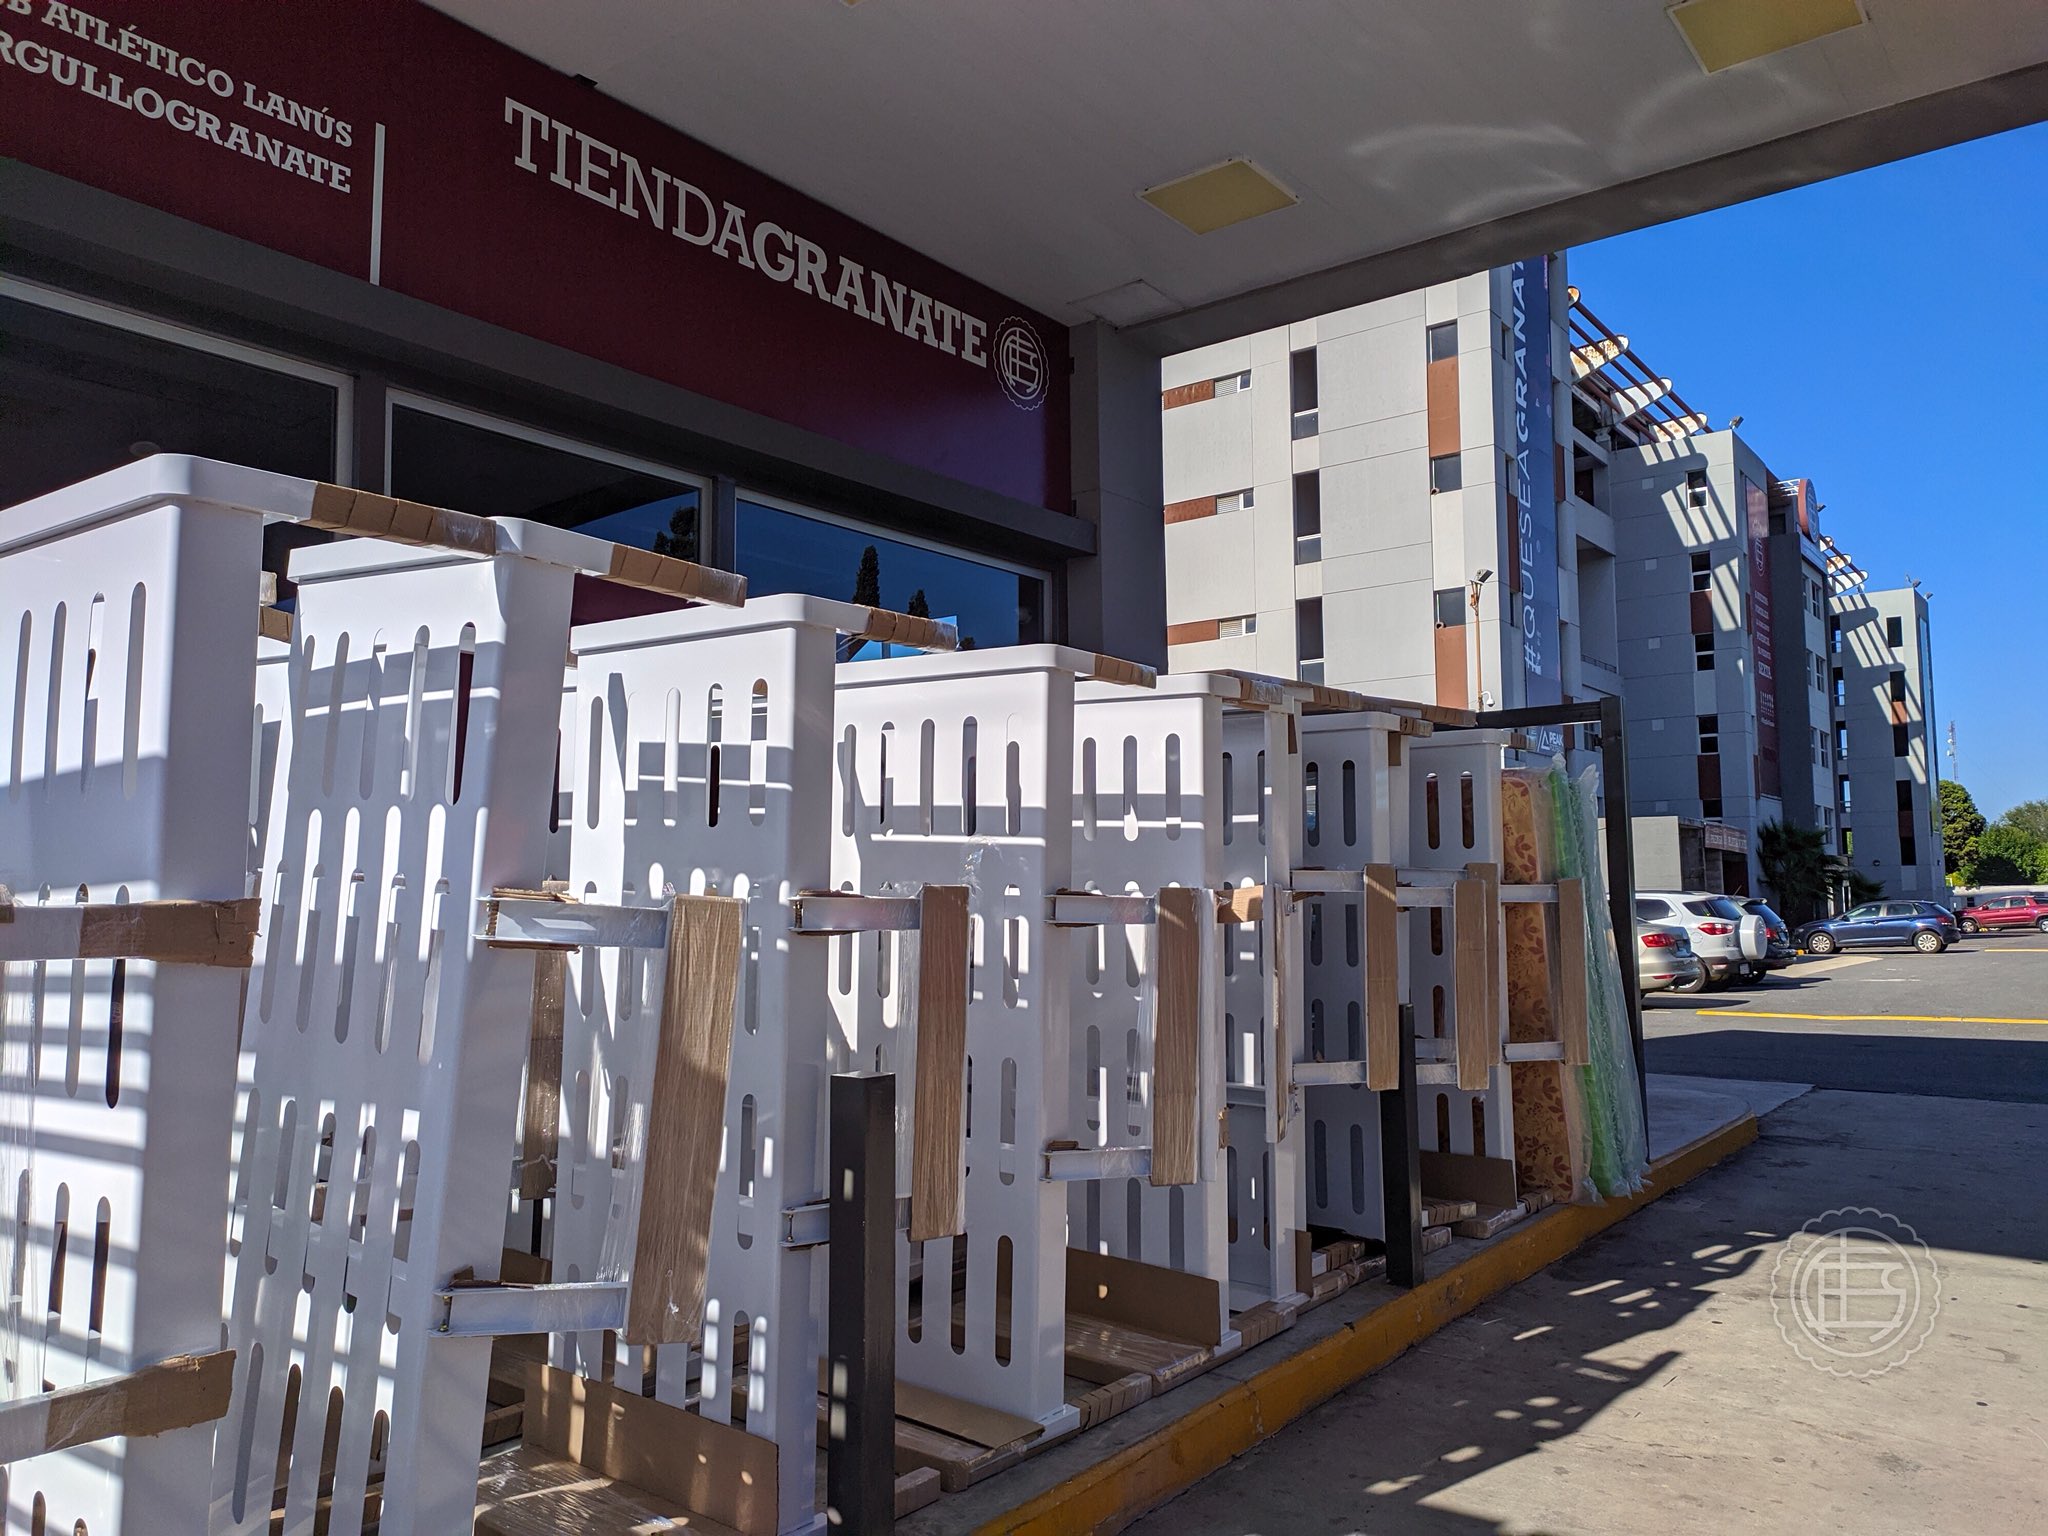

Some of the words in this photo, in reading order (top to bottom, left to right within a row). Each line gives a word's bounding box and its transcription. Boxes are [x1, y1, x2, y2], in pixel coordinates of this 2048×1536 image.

[41, 0, 234, 98] ATLÉTICO
[243, 81, 353, 147] LANÚS
[504, 97, 988, 368] TIENDAGRANATE
